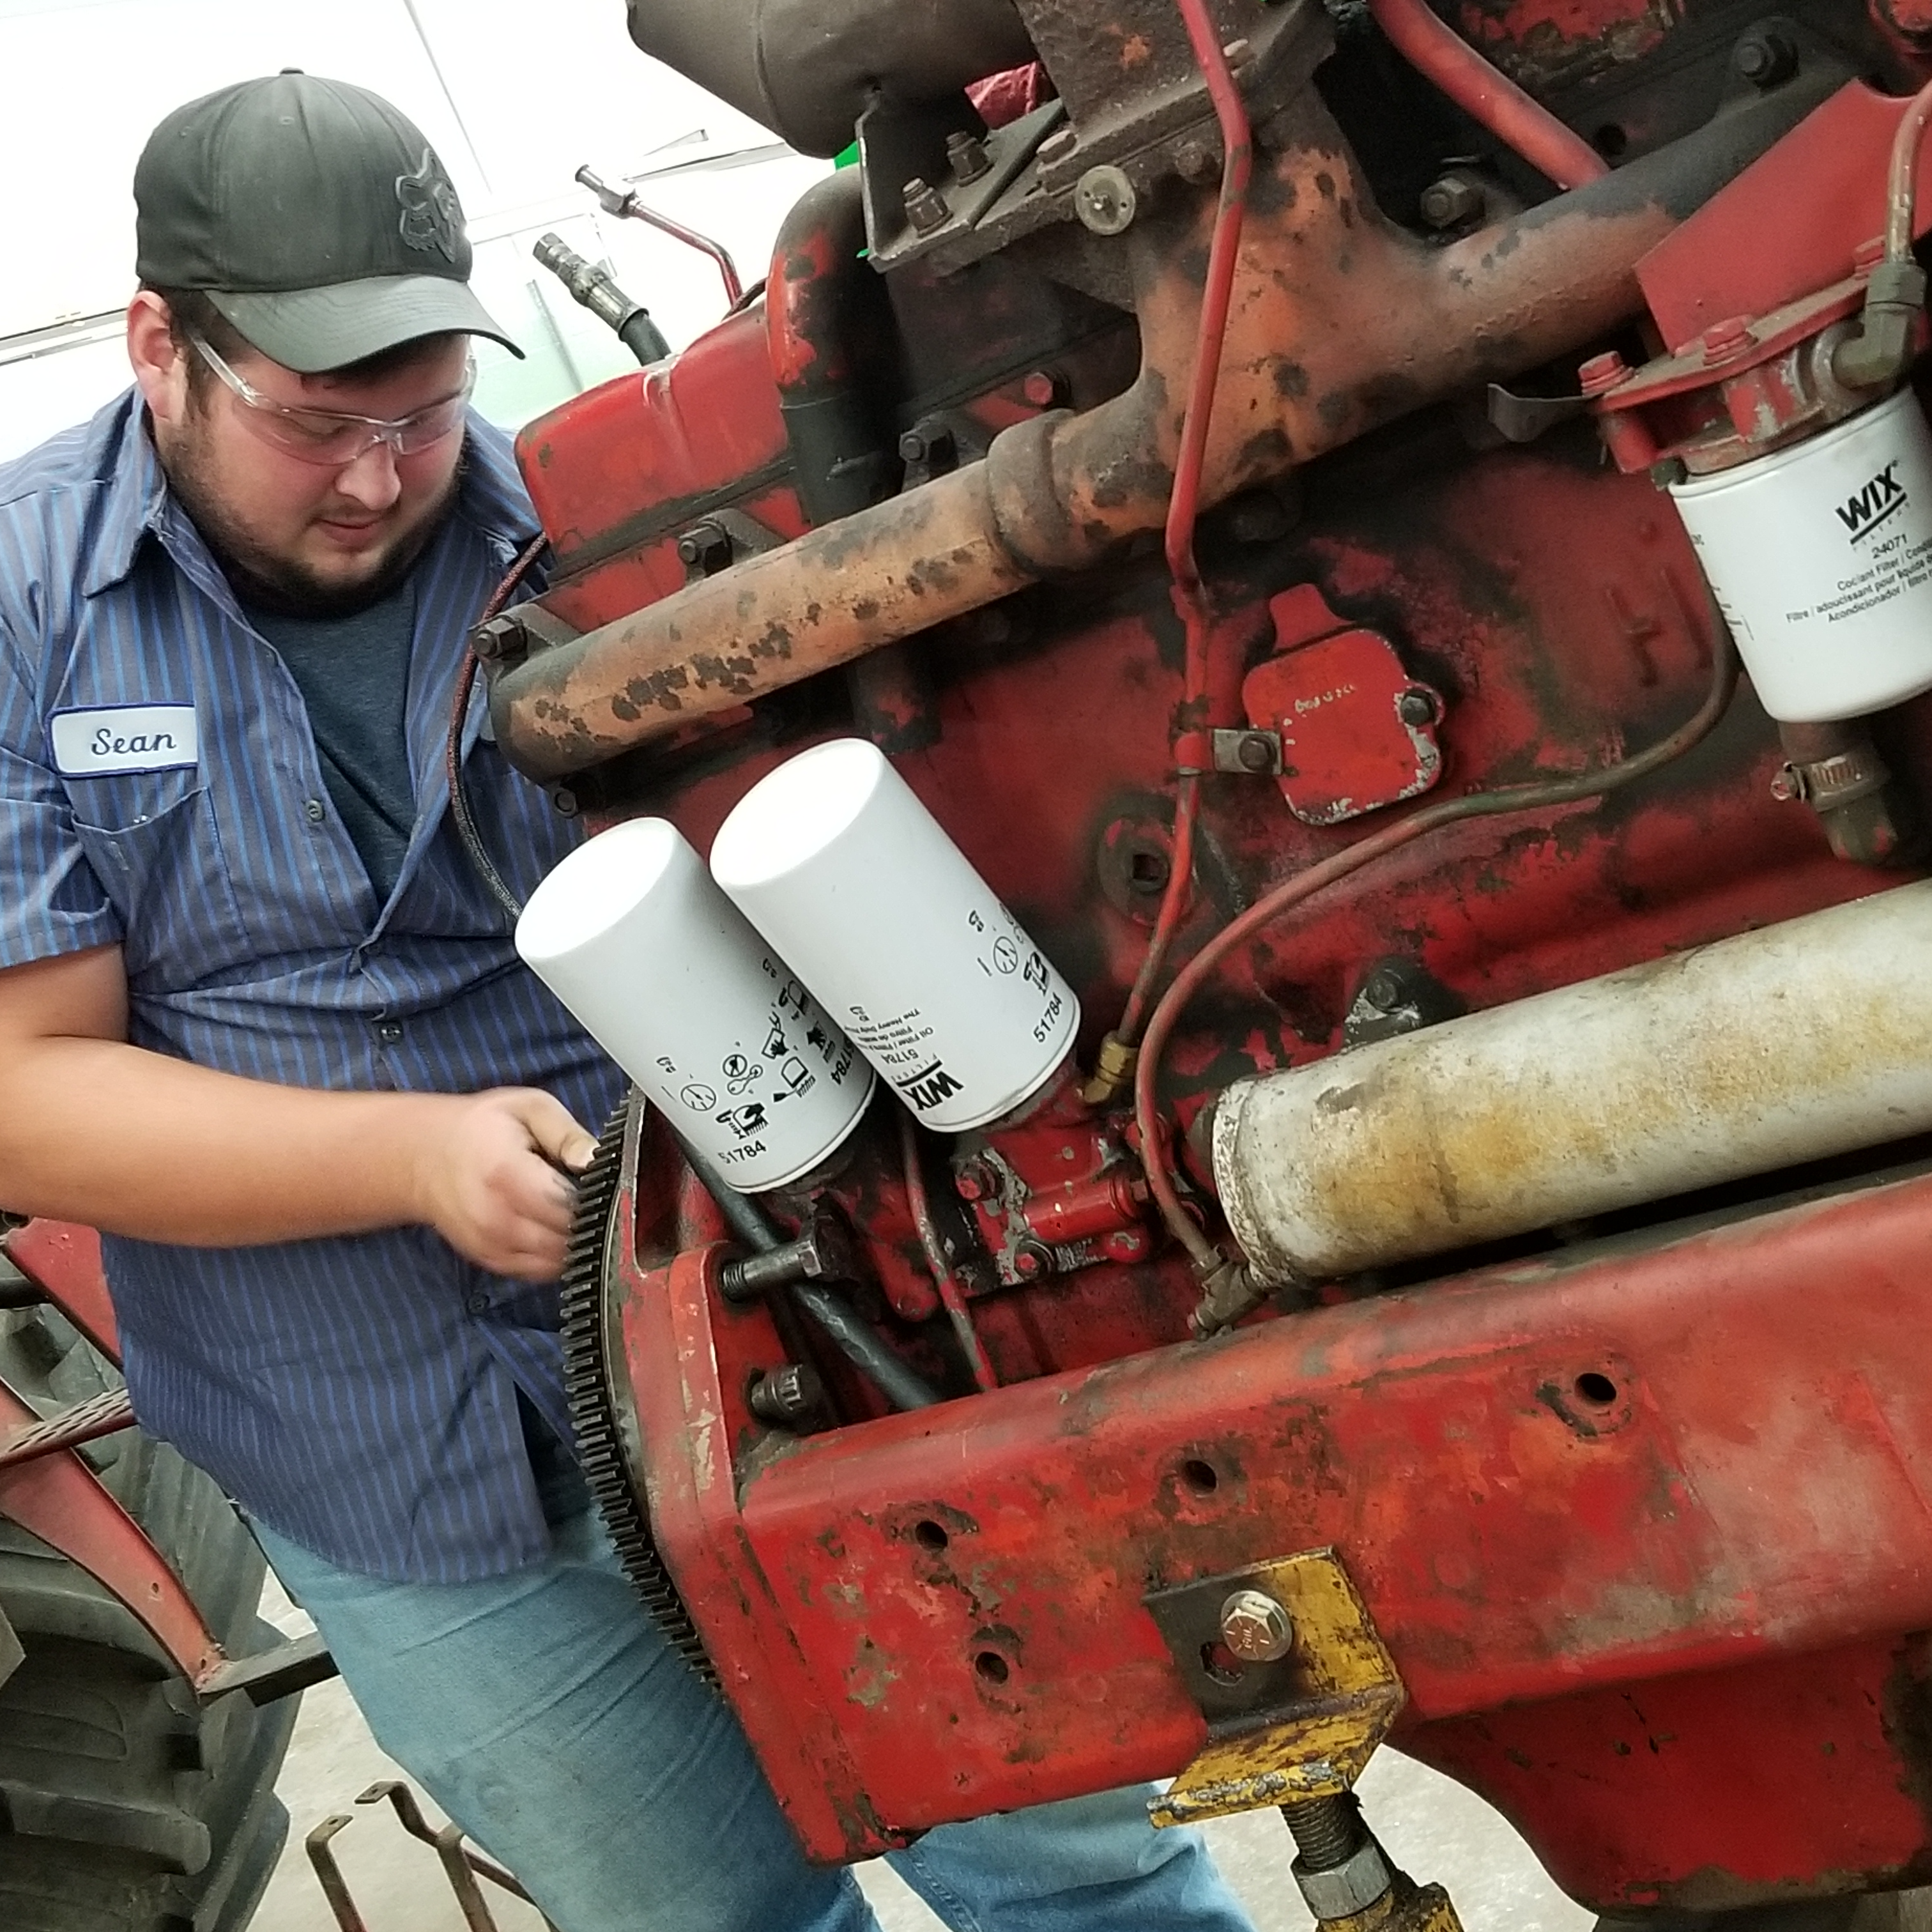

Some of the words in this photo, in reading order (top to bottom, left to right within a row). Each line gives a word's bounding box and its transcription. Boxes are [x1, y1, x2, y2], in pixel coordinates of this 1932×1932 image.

[1836, 464, 1903, 532] WIX
[1871, 533, 1907, 560] 24071
[91, 728, 177, 755] Sean
[1032, 993, 1063, 1043] 51784
[881, 1048, 919, 1064] 51784
[903, 1071, 963, 1110] WIX
[718, 1140, 767, 1165] 51784
